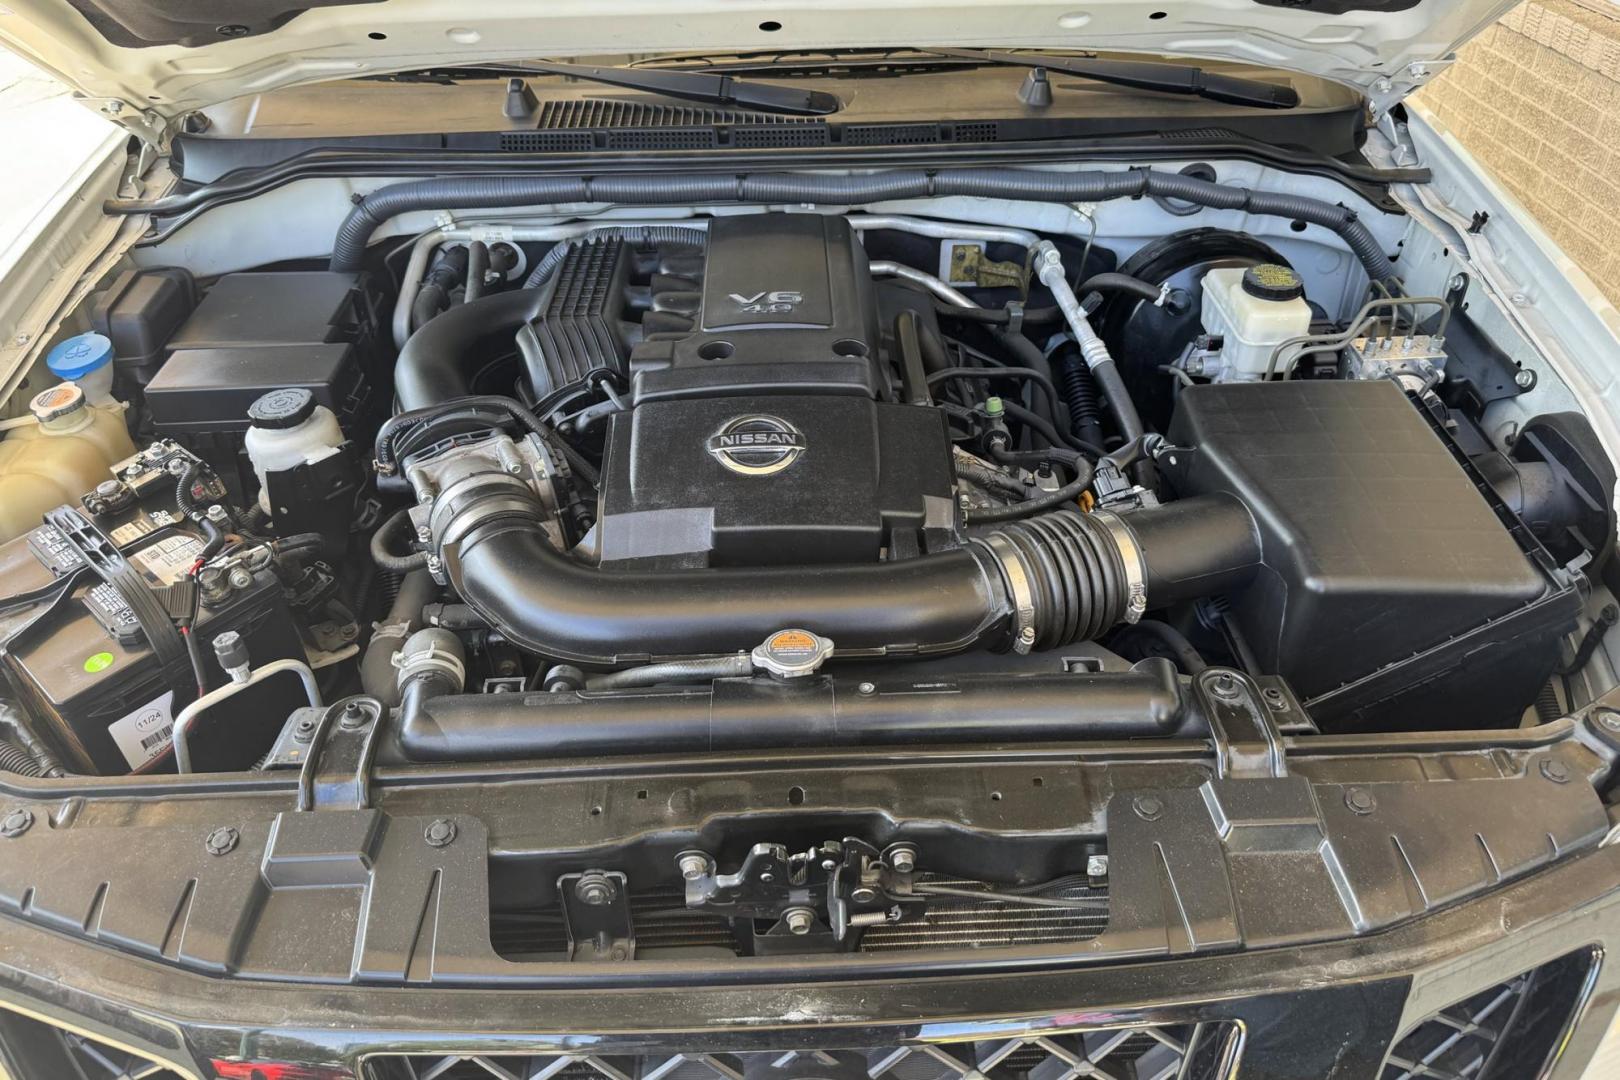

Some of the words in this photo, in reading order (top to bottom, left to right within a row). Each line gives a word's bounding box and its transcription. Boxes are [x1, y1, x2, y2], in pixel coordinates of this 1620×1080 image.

[728, 291, 803, 304] V6
[720, 433, 797, 446] NISSAN
[137, 711, 161, 729] 11/24
